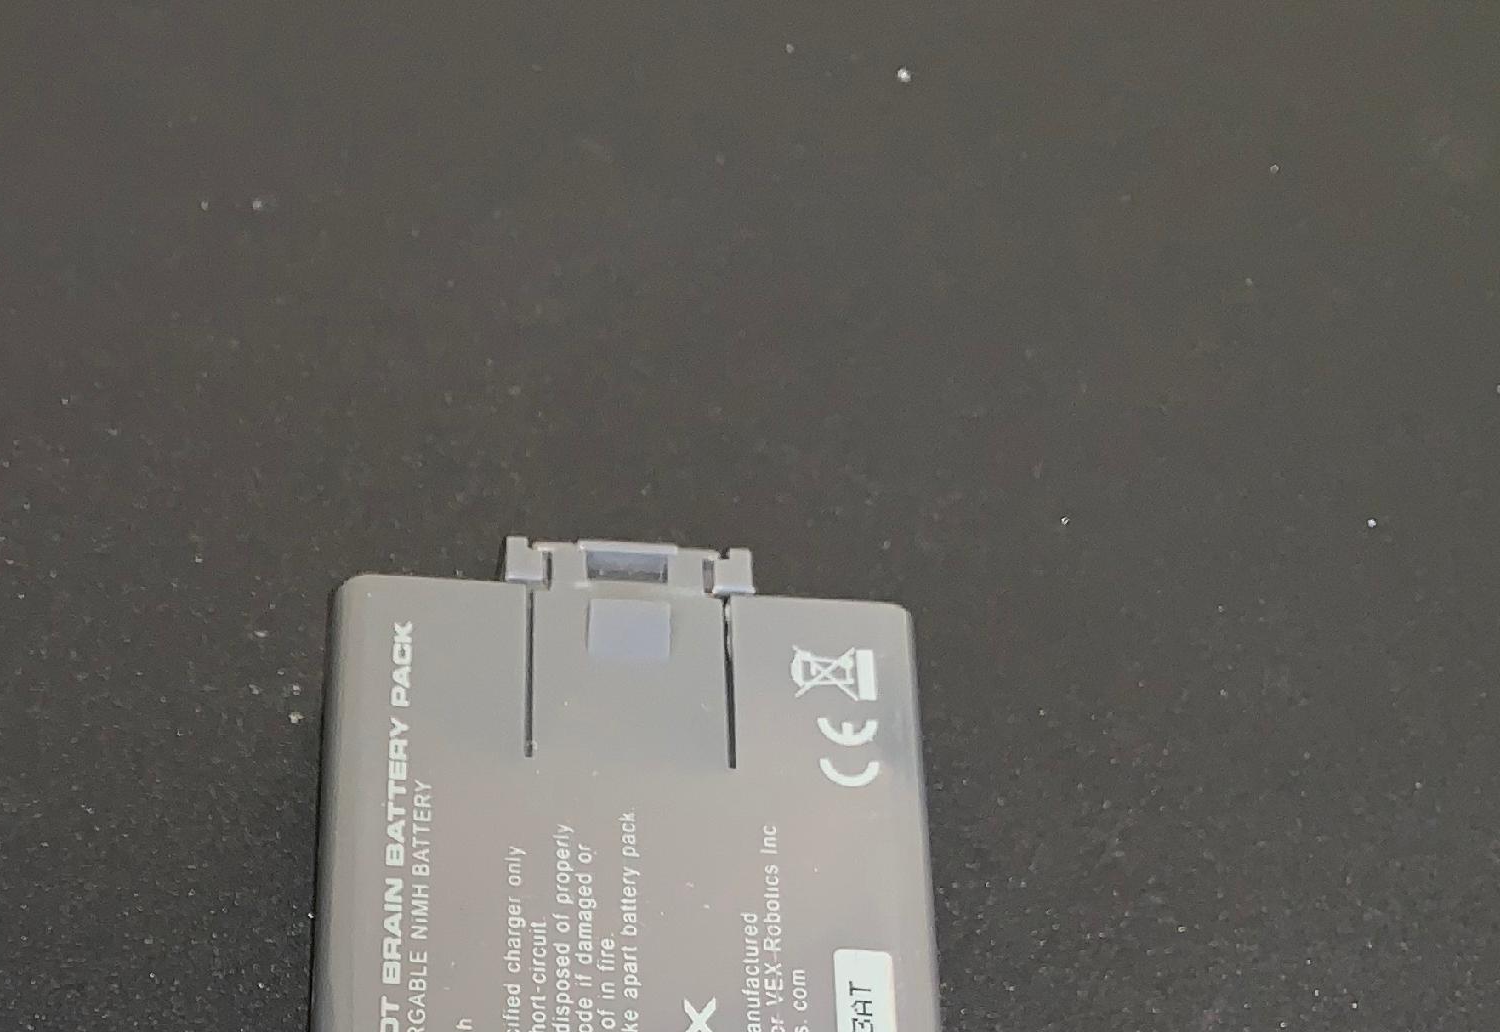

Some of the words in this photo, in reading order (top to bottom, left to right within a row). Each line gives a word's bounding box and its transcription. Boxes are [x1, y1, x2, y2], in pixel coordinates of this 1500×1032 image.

[390, 621, 412, 707] PACK
[817, 717, 880, 786] CE
[386, 718, 409, 866] BATTERY
[412, 780, 432, 876] BATTERY
[578, 844, 592, 864] or
[760, 825, 778, 854] Inc
[504, 846, 526, 886] only
[553, 824, 574, 904] properly
[411, 884, 429, 940] NiMH
[552, 914, 570, 933] of
[575, 872, 597, 964] damaged
[620, 866, 640, 936] battery
[764, 864, 782, 952] Robotics
[382, 878, 403, 984] BRAIN
[504, 896, 526, 973] charger
[596, 932, 615, 972] fire.
[574, 974, 592, 986] if
[598, 982, 615, 999] in
[620, 946, 640, 999] apart
[764, 962, 783, 1006] VEX
[597, 1008, 616, 1030] of
